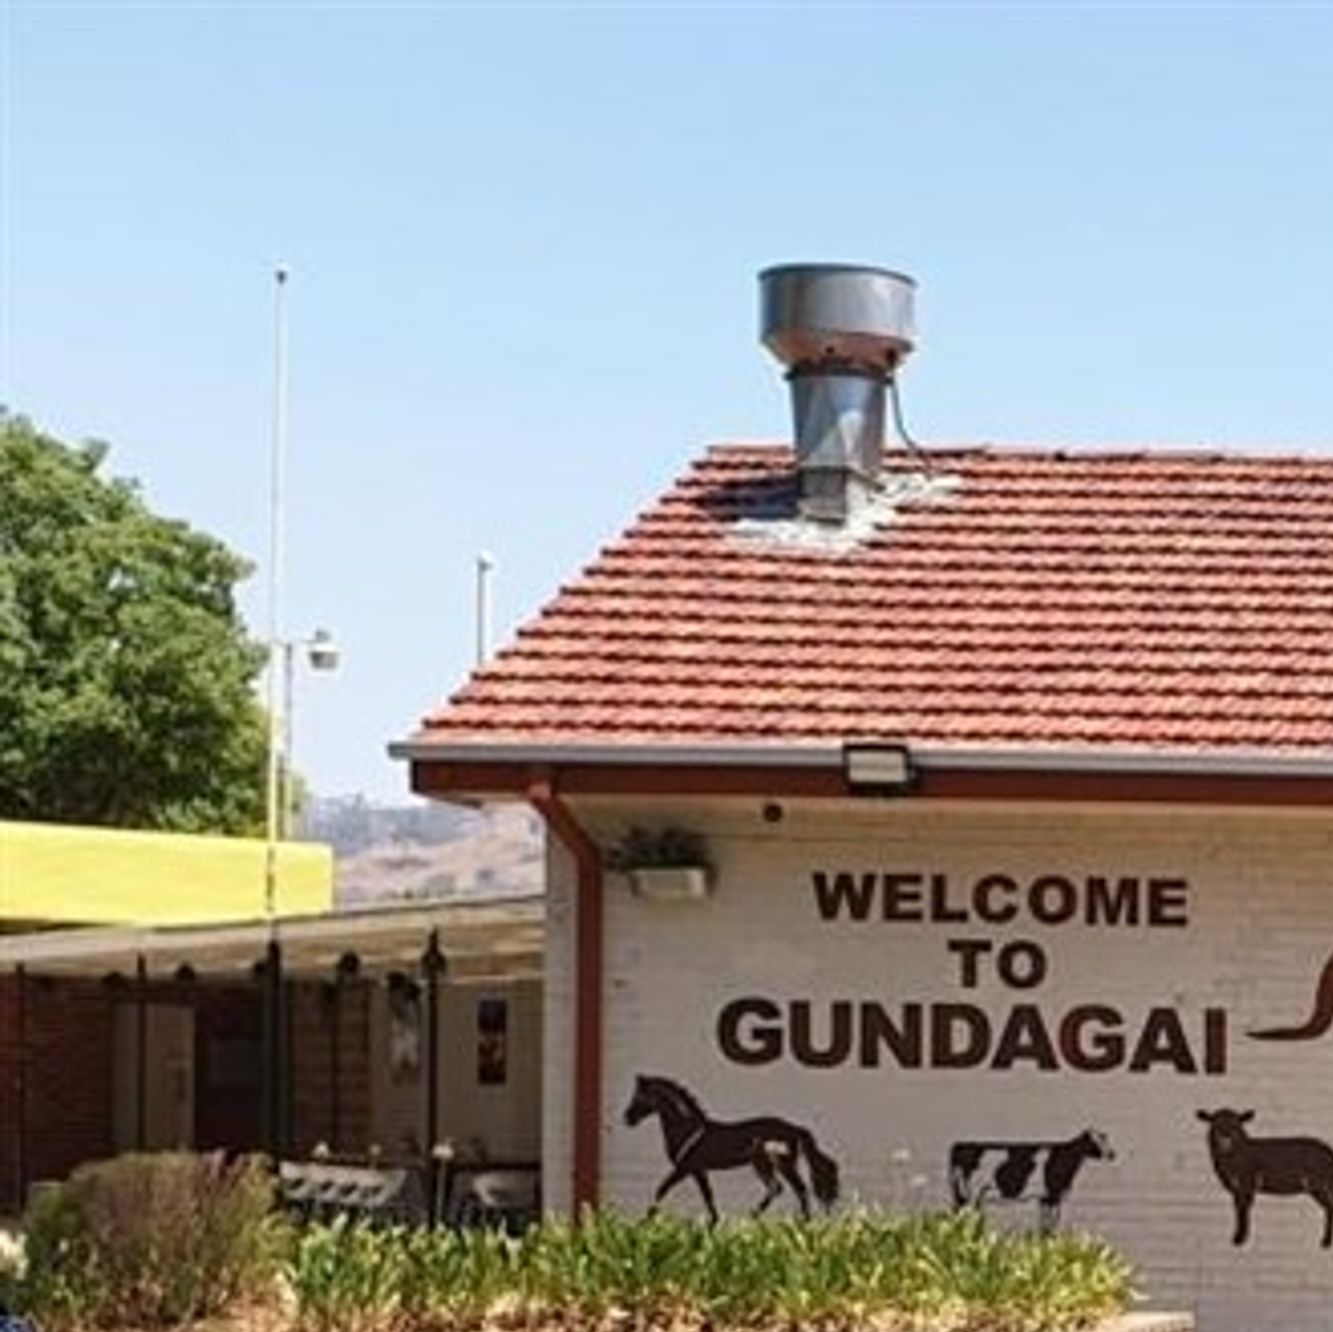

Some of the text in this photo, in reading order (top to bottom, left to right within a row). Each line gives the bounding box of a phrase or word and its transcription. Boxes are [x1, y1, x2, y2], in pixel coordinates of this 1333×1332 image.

[812, 871, 1189, 927] WELCOME
[948, 939, 1047, 989] TO
[716, 999, 1228, 1075] GUNDAGAI
